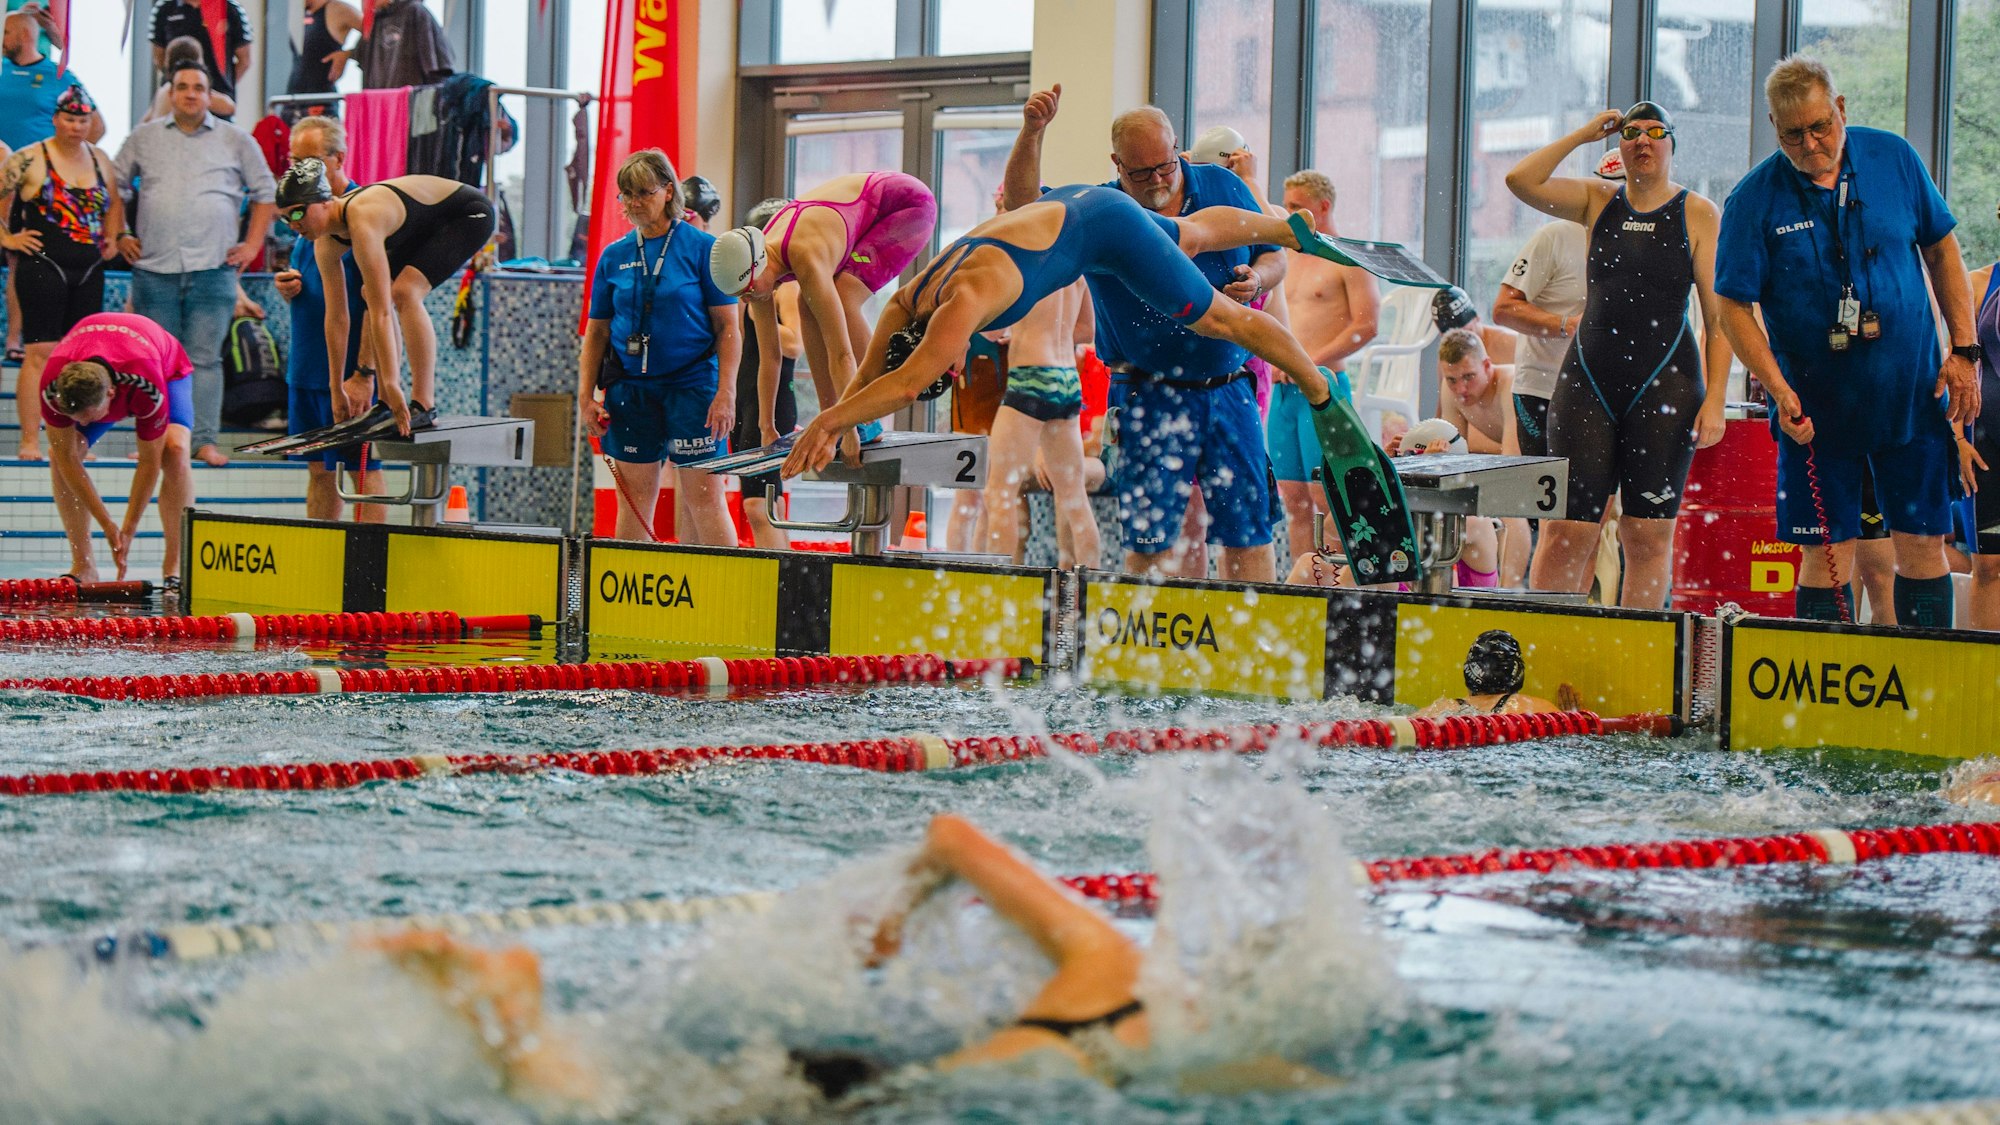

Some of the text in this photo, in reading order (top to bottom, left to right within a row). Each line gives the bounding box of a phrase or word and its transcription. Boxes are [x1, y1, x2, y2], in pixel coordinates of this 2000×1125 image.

[1621, 220, 1656, 232] arena
[1775, 220, 1815, 235] DLRG
[619, 261, 643, 270] DLRG
[738, 261, 759, 281] area
[514, 427, 525, 460] 1
[624, 445, 638, 454] HSK
[674, 436, 716, 448] DLRG
[955, 450, 977, 482] 2
[1536, 475, 1557, 511] 3
[200, 540, 277, 575] OMEGA
[600, 570, 694, 609] OMEGA
[1098, 607, 1220, 653] OMEGA
[1748, 657, 1910, 711] OMEGA
